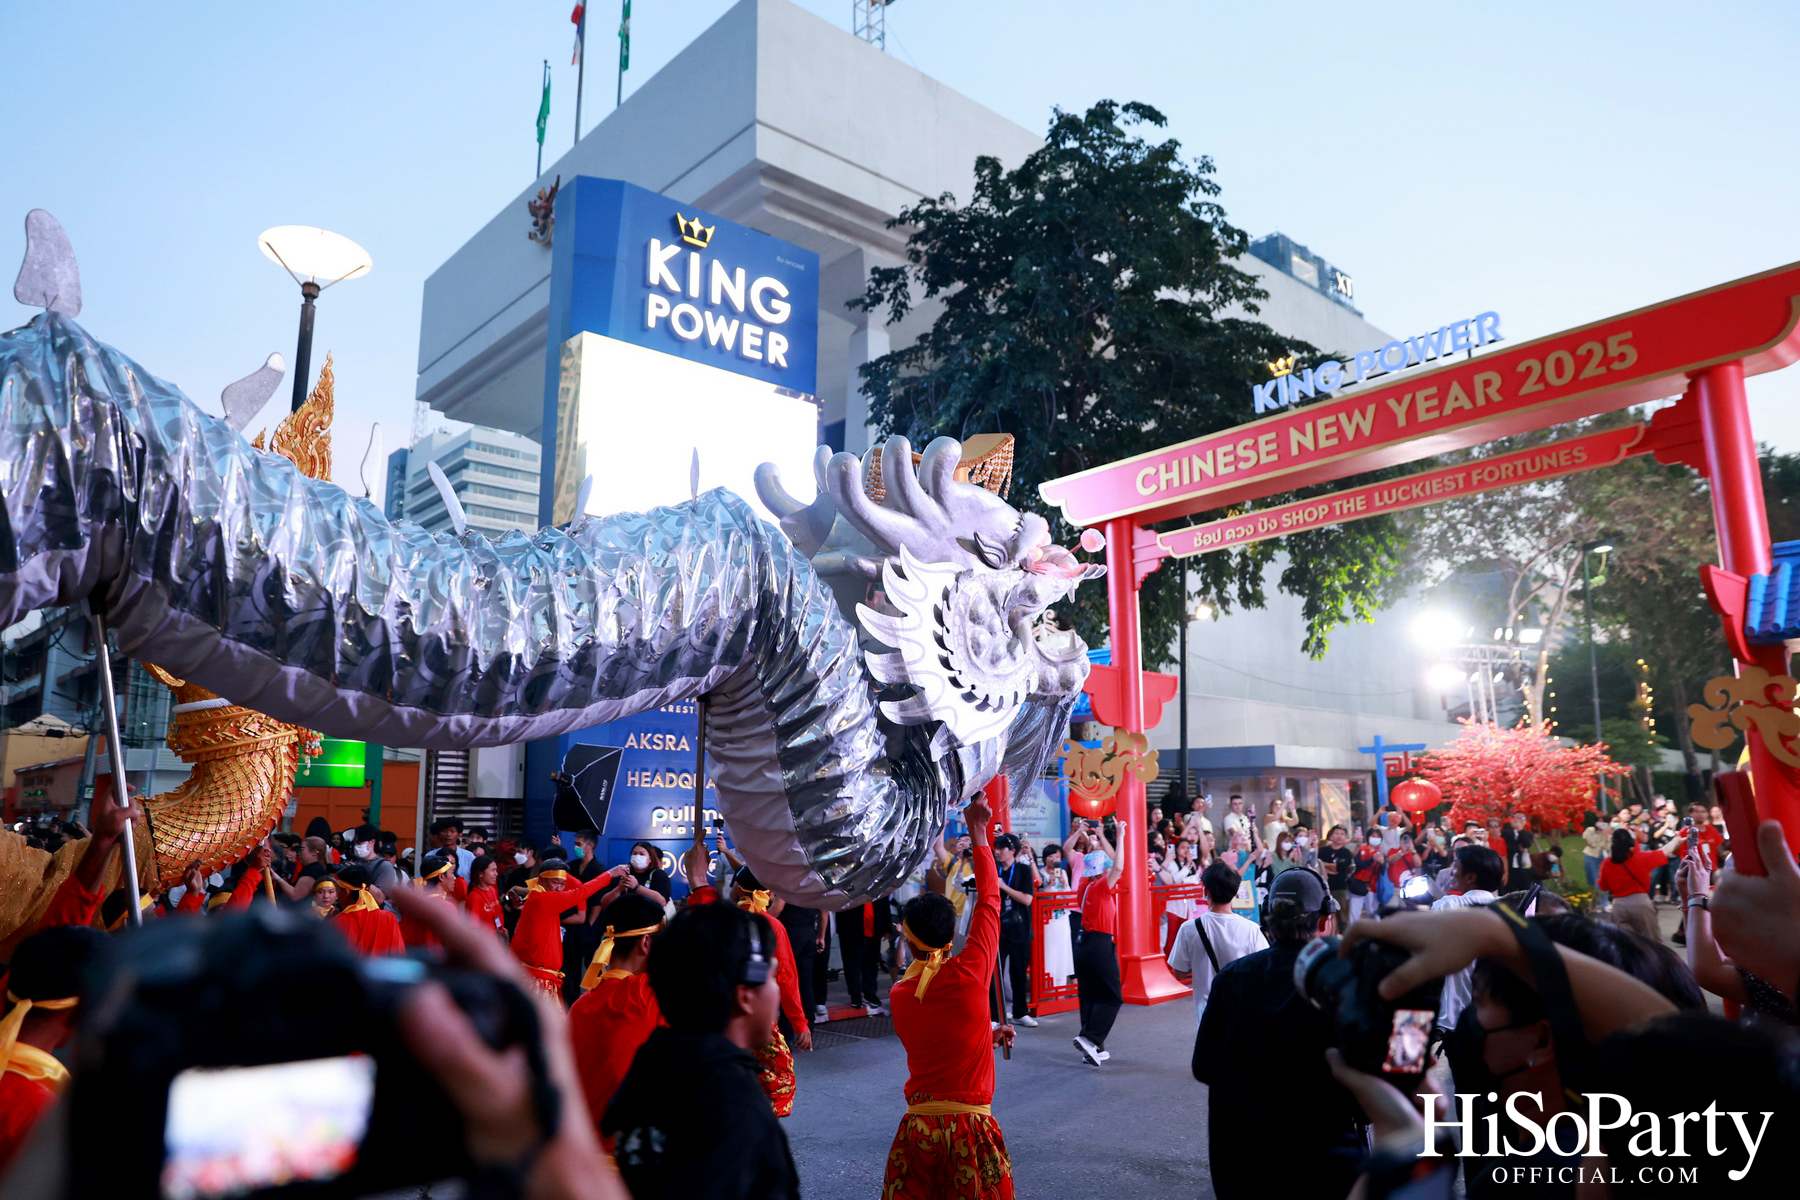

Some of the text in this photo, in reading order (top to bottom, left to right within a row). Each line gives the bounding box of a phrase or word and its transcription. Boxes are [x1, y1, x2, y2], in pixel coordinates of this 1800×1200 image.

[649, 237, 792, 325] KING
[647, 293, 790, 369] POWER
[1252, 311, 1504, 414] KING POWER
[1135, 331, 1639, 496] CHINESE NEW YEAR 2025
[1225, 524, 1255, 541] ดวง
[1281, 504, 1330, 528] SHOP
[1332, 495, 1368, 516] THE
[1374, 472, 1467, 507] LUCKIEST
[1471, 446, 1588, 486] FORTUNES
[624, 732, 691, 752] AKSRA
